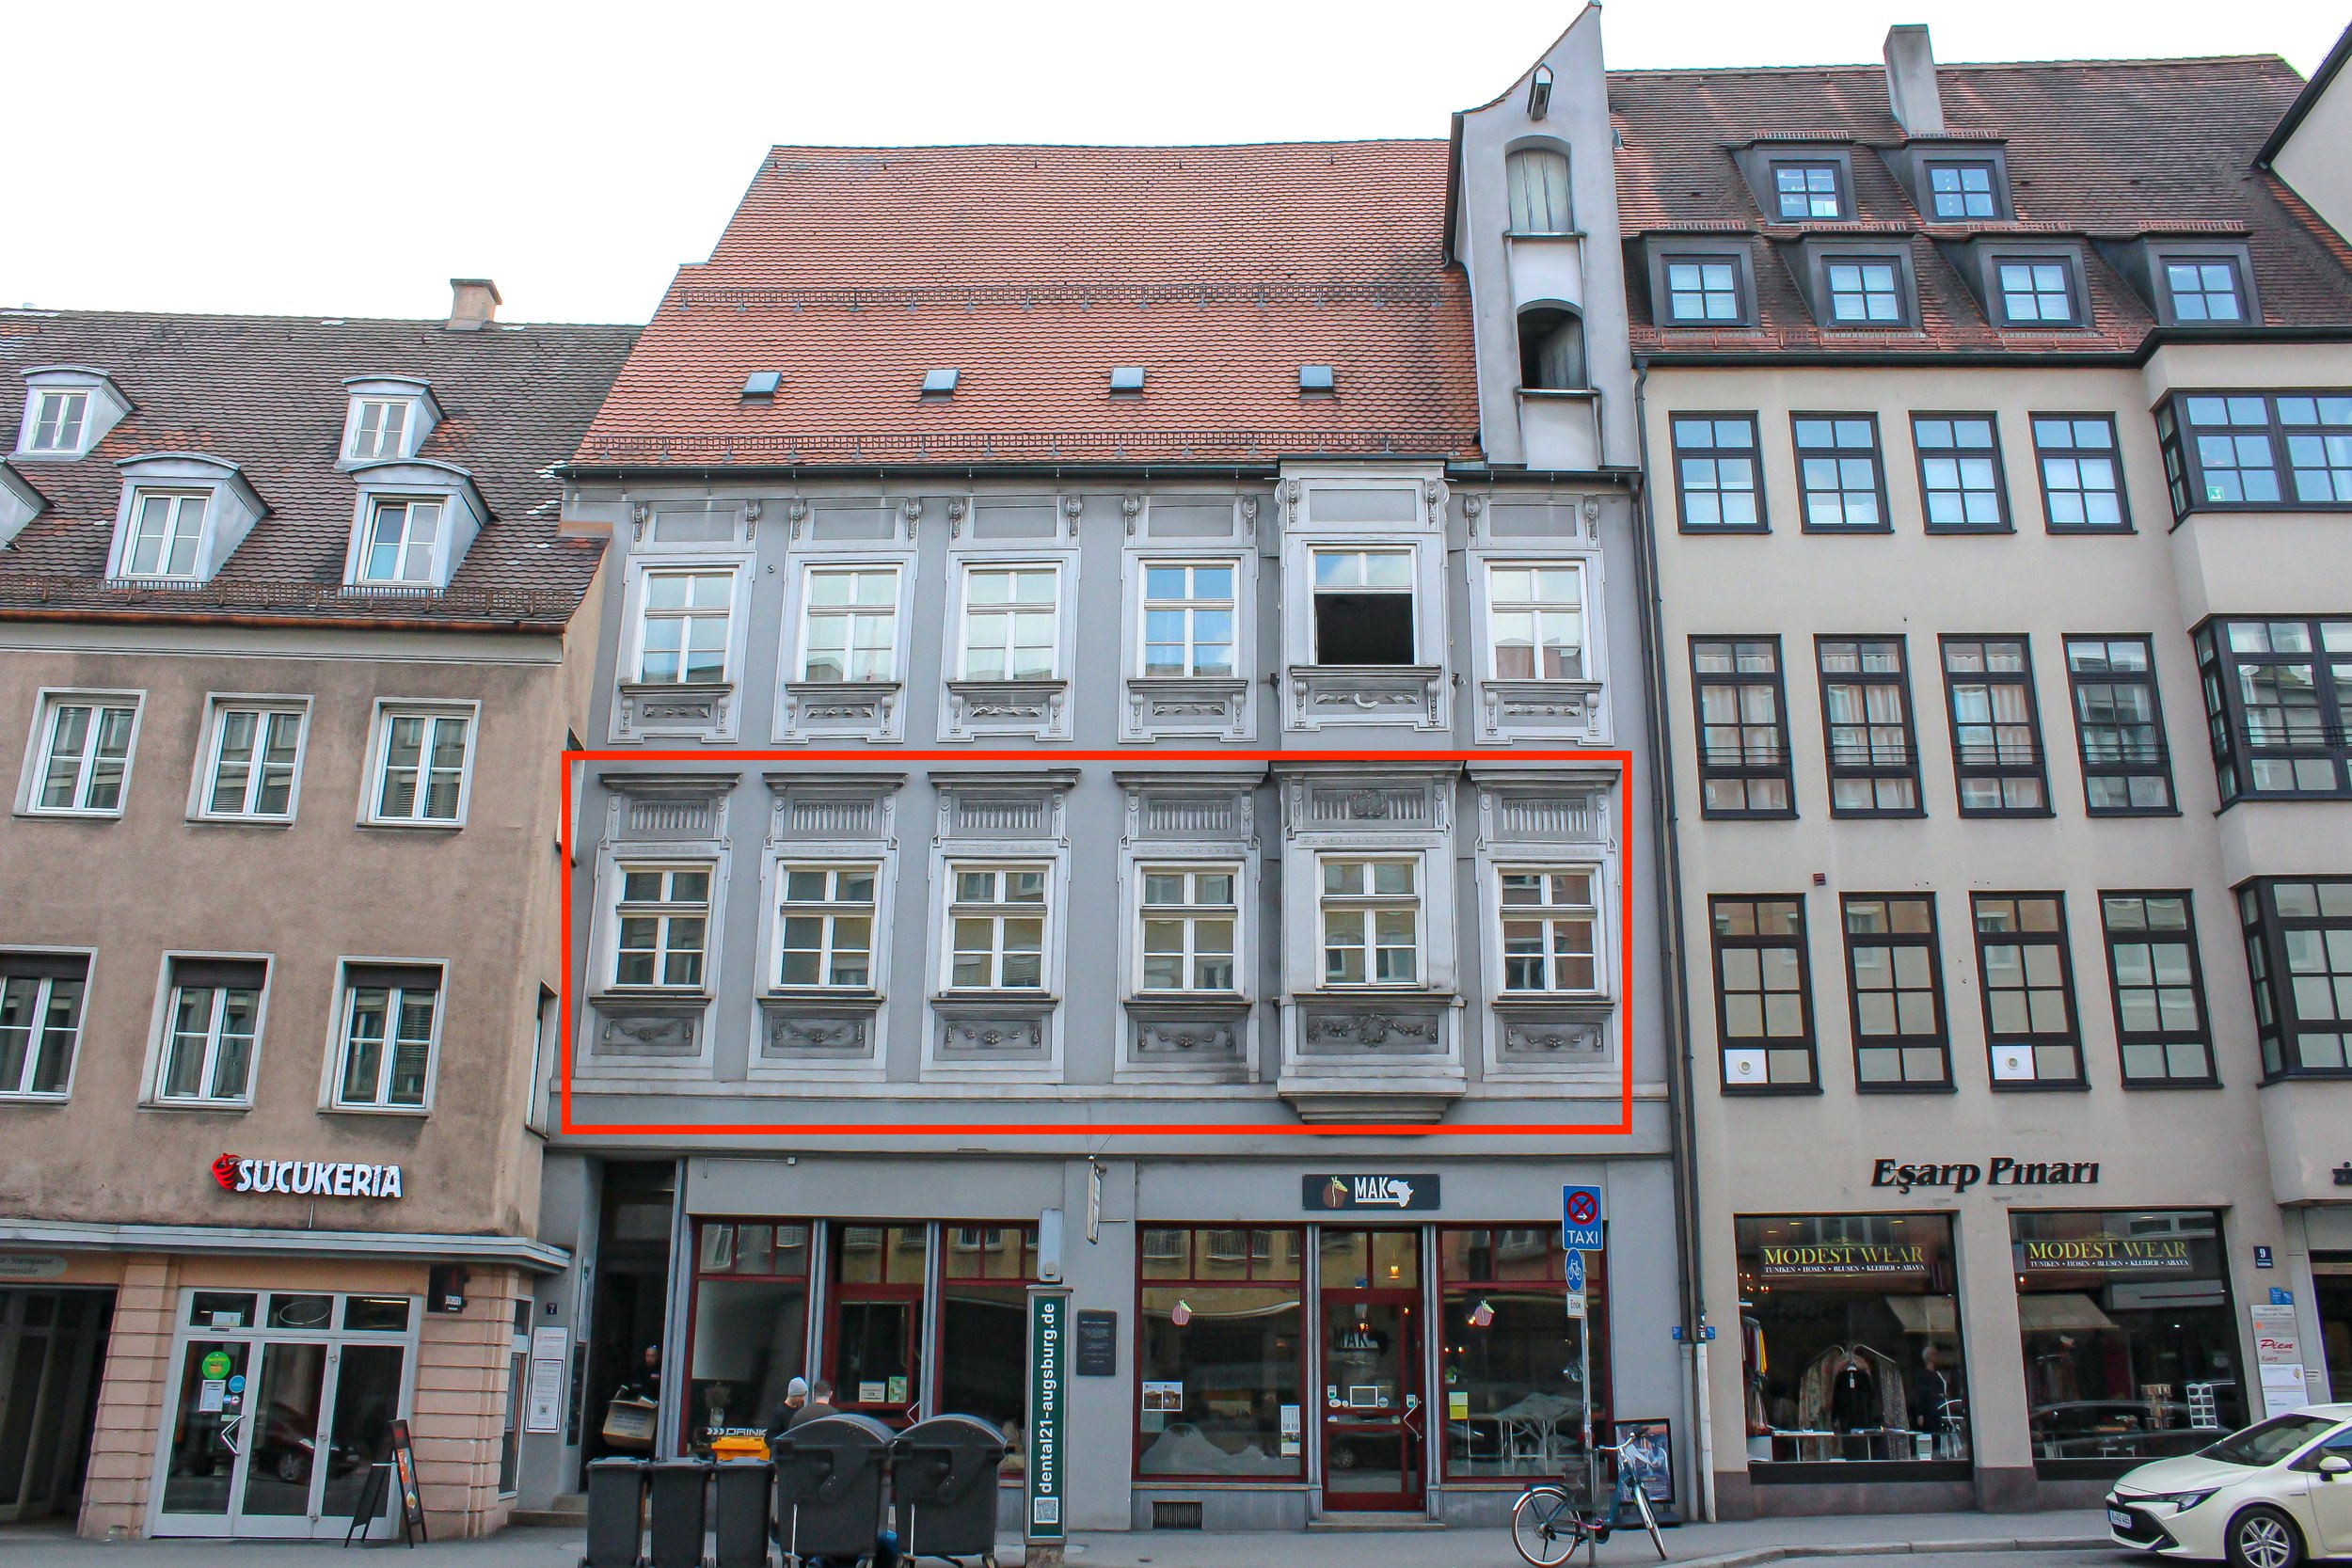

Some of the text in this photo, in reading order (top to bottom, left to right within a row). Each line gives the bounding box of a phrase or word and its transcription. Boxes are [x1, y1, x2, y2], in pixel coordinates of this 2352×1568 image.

[235, 1158, 404, 1198] SUCUKERIA
[1871, 1158, 1981, 1194] Eşarp
[1355, 1176, 1390, 1198] MAK
[1566, 1229, 1598, 1244] TAXI
[1763, 1245, 1924, 1265] MODEST WEAR
[2027, 1241, 2187, 1259] MODEST WEAR
[2259, 1247, 2266, 1259] 9
[1039, 1303, 1057, 1494] dental21-augsburg.de
